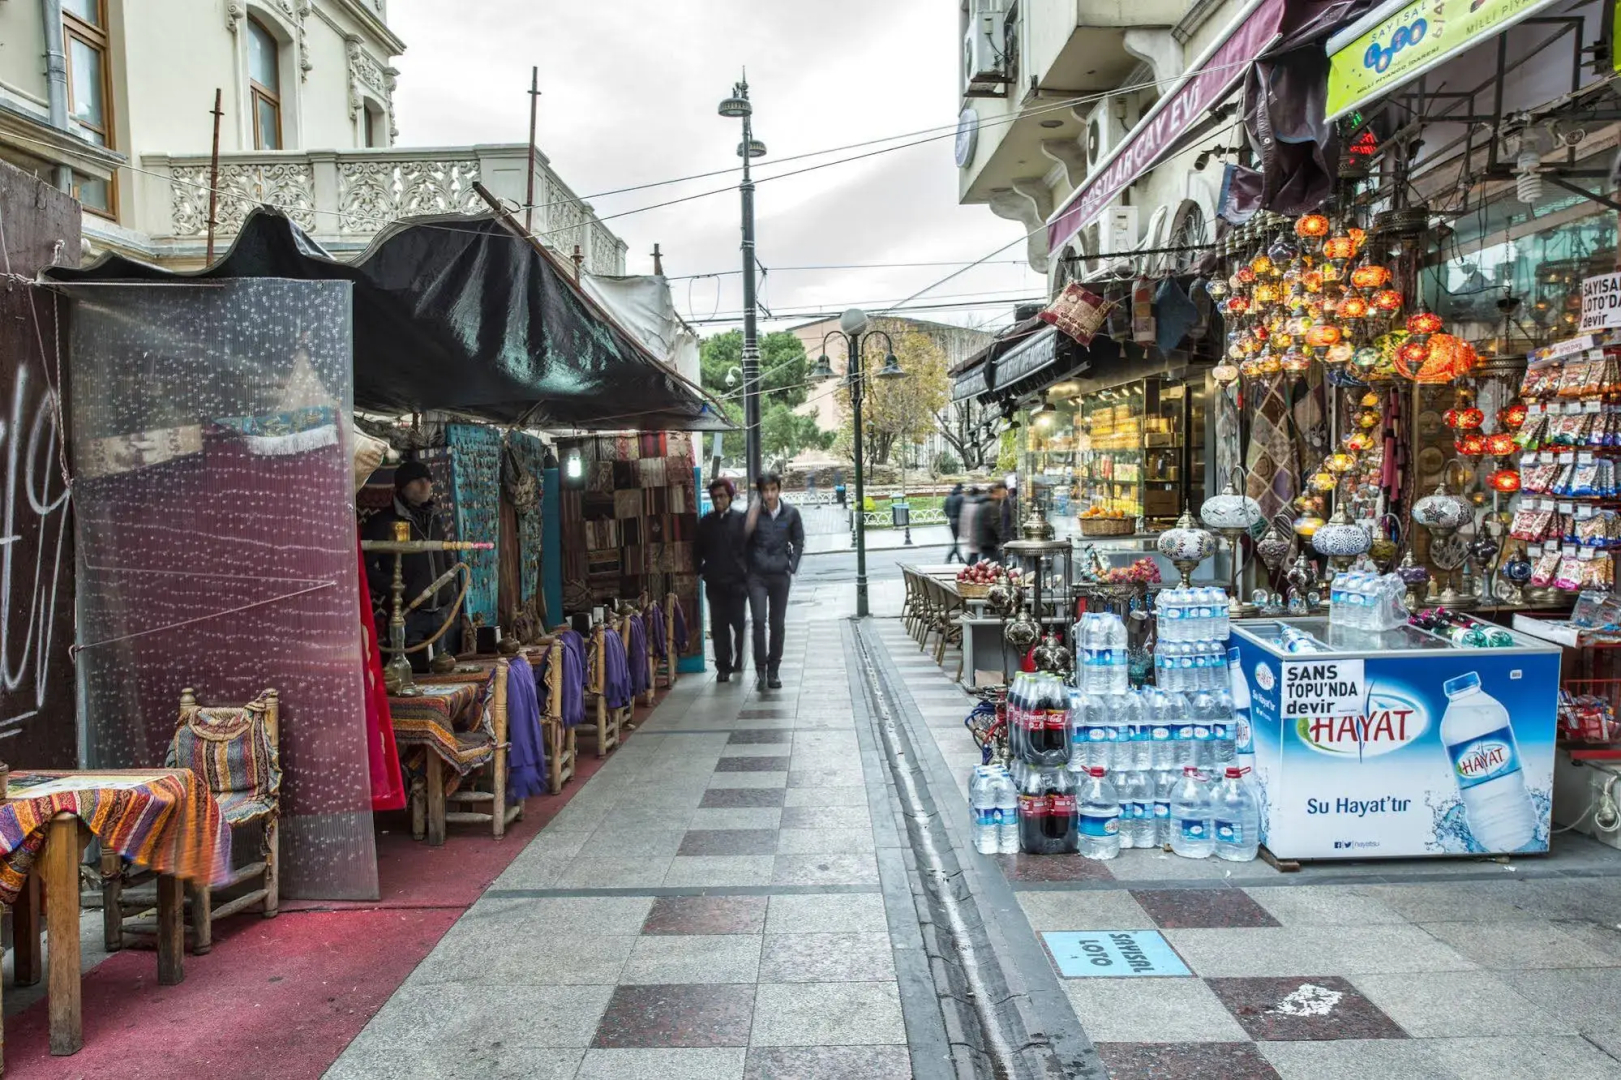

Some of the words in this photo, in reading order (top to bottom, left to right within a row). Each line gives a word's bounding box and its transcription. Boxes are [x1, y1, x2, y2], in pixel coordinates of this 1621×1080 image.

[1371, 2, 1426, 42] SAYISAL
[1364, 19, 1427, 73] LOTO
[1584, 277, 1621, 297] SAYISA
[1583, 312, 1608, 328] devir
[1287, 681, 1358, 698] TOPU'NDA
[1286, 699, 1335, 714] devir
[1309, 710, 1414, 742] HAYAT
[1462, 747, 1503, 774] HAYAT
[1307, 797, 1329, 814] Su
[1336, 796, 1411, 817] Hayat'tır
[1079, 939, 1113, 967] LOTO
[1108, 933, 1155, 973] SAYISAL
